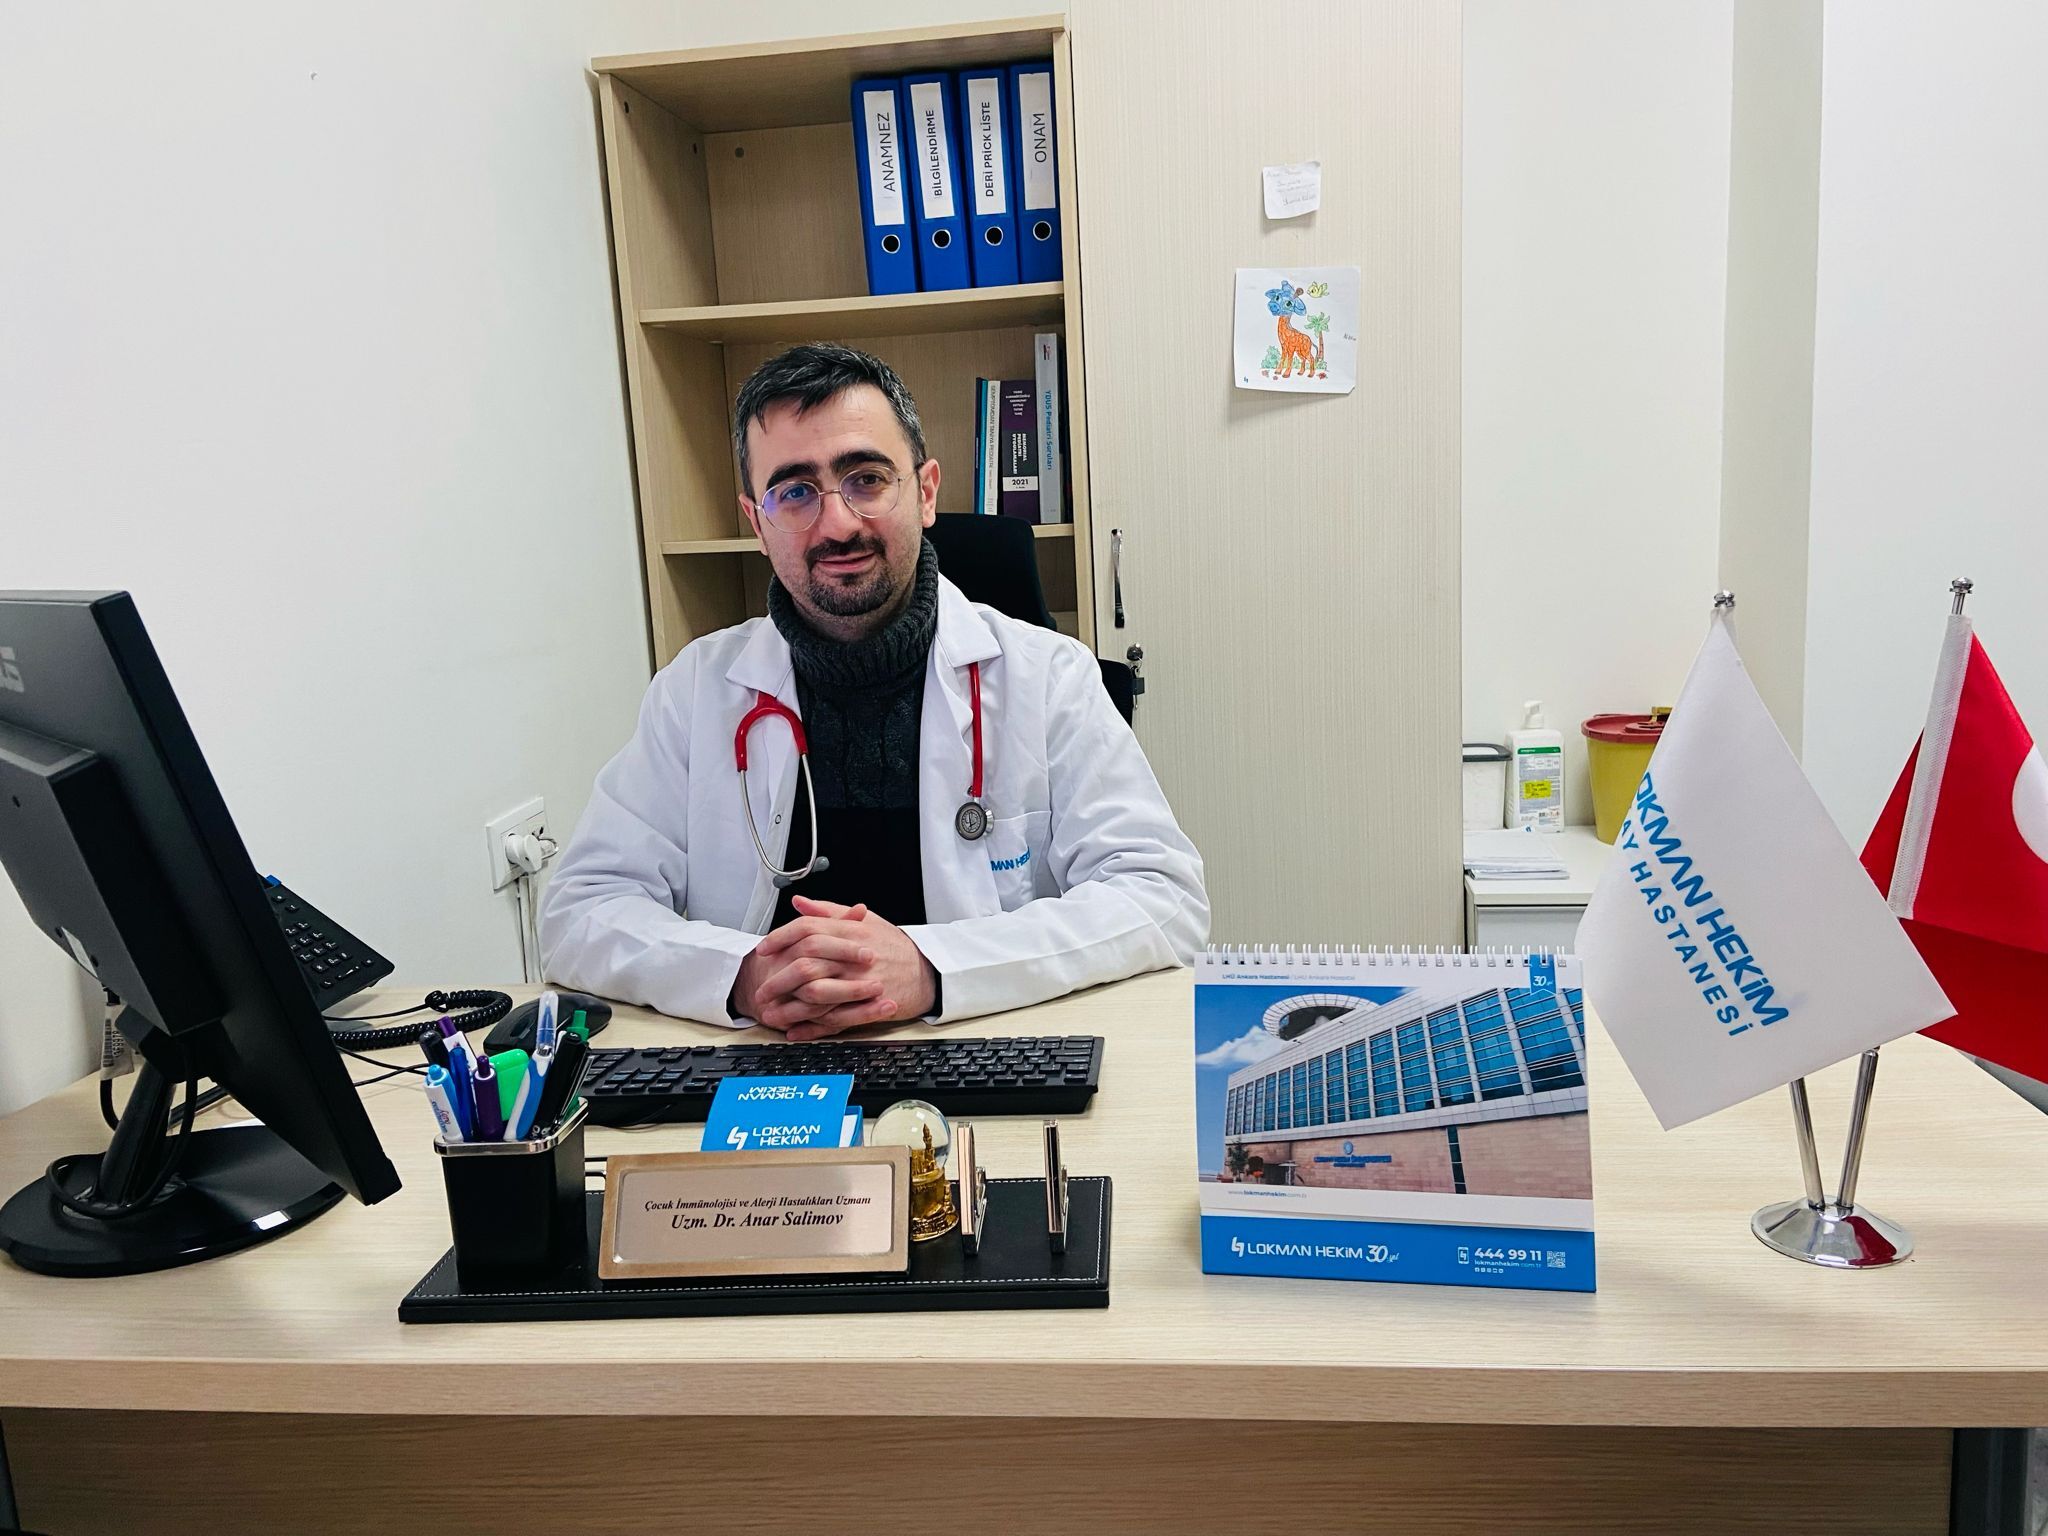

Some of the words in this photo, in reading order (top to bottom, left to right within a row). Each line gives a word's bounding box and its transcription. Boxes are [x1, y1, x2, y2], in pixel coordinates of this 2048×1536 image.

[980, 101, 991, 131] LİSTE
[1032, 113, 1047, 163] ONAM
[878, 112, 896, 192] ANAMNEZ
[925, 109, 942, 197] BİLGİLENDİRME
[983, 171, 994, 197] DERİ
[1636, 772, 1713, 907] OKMAN
[990, 859, 1014, 871] MAN
[1630, 860, 1754, 1037] HASTANESİ
[738, 1092, 804, 1100] LOKMAN
[752, 1124, 821, 1137] LOKMAN
[645, 1200, 674, 1211] Çocuk
[675, 1198, 737, 1210] İmmünolojisi
[750, 1197, 777, 1209] Alerji
[779, 1196, 833, 1206] Hastalıkları
[836, 1195, 871, 1205] Uzmanı
[671, 1214, 707, 1229] Uzm.
[713, 1213, 736, 1227] Dr.
[739, 1212, 779, 1227] Anar
[782, 1211, 844, 1226] Salimov
[1247, 1243, 1312, 1257] LOKMAN
[1474, 1247, 1504, 1259] 444
[1508, 1249, 1527, 1260] 99
[1529, 1250, 1542, 1261] 11
